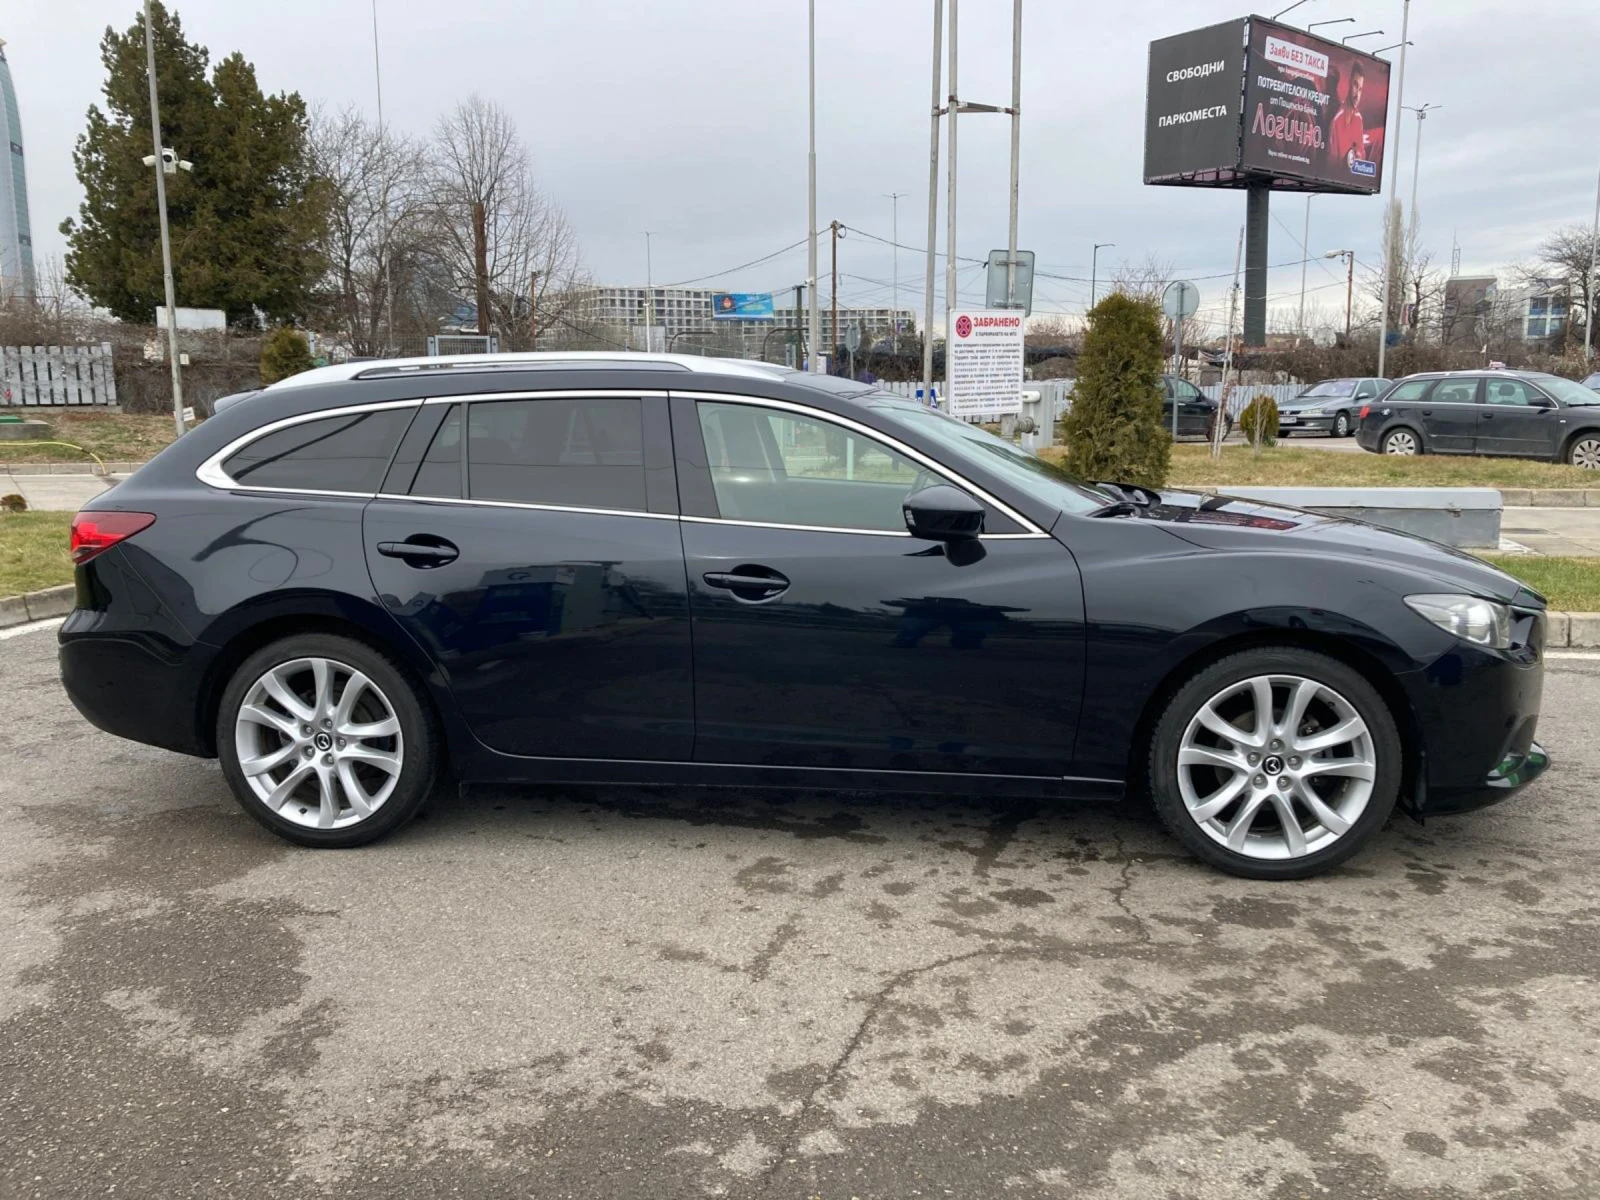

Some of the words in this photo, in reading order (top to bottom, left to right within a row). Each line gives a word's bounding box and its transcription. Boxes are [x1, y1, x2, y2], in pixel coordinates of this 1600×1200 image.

[1269, 42, 1290, 59] Заяви
[1290, 49, 1303, 63] БЕЗ
[1304, 54, 1325, 71] ТАКСА
[1166, 60, 1225, 83] СВОБОДНИ
[1257, 75, 1308, 98] ПОТРЕБИТЕЛСКИ
[1308, 90, 1331, 105] КРЕДИТ
[1158, 105, 1227, 127] ПАРКОМЕСТА
[1251, 102, 1325, 149] Логично.
[1354, 161, 1373, 173] Postbank
[973, 316, 1020, 327] ЗАБРАНЕНО
